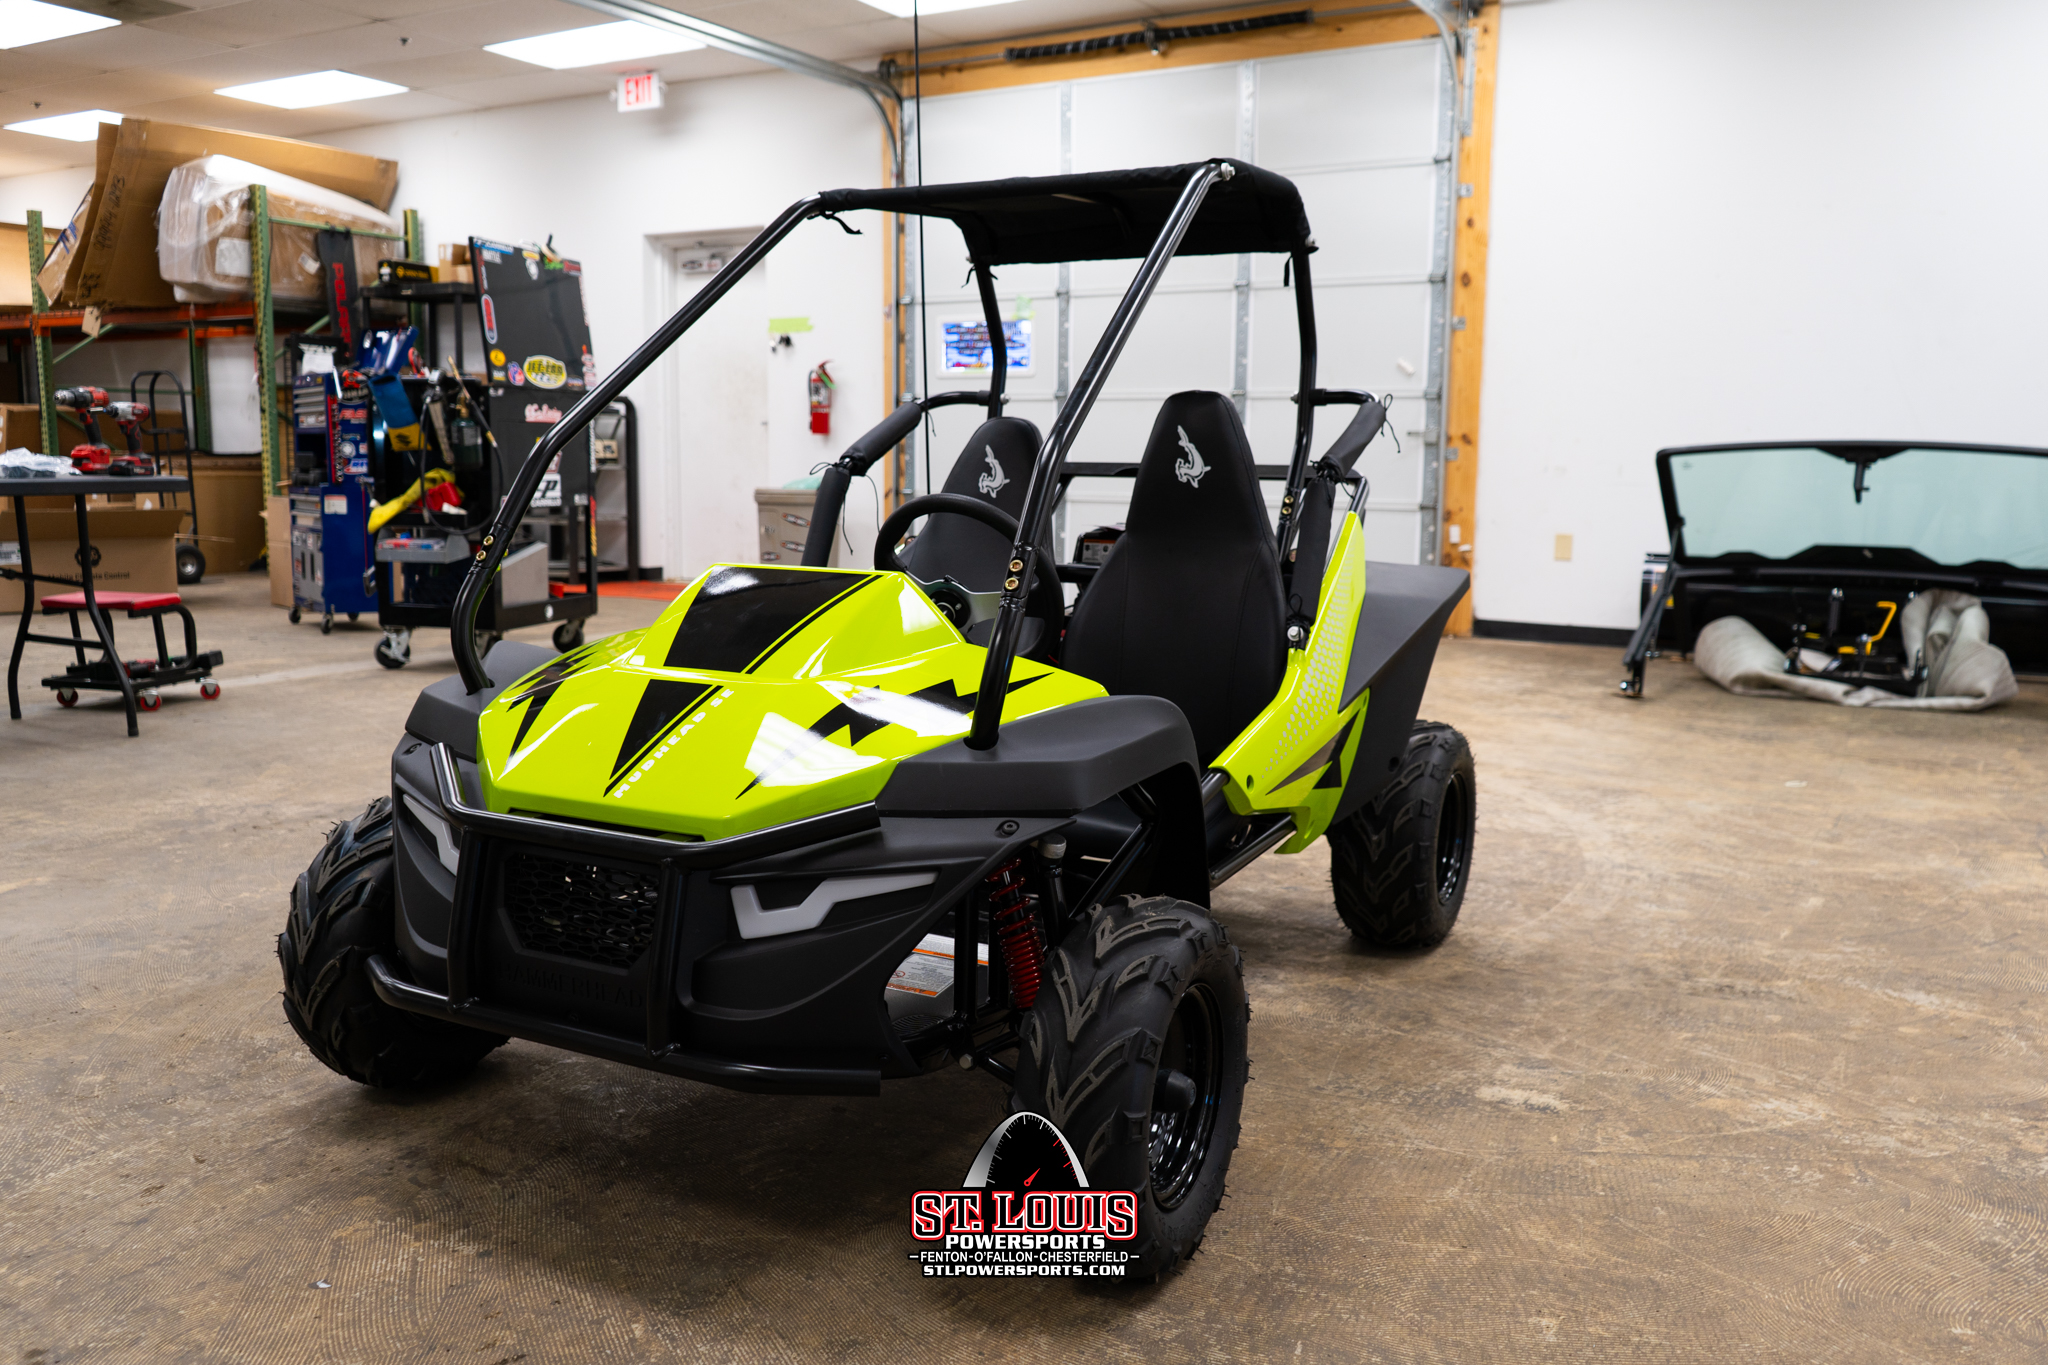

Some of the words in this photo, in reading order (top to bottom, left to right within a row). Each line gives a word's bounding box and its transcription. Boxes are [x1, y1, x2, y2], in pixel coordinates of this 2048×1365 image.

[624, 74, 653, 107] EXIT
[104, 571, 130, 580] Control
[613, 711, 706, 798] MUDHEAD
[710, 688, 735, 707] SE
[499, 962, 642, 1007] HAMMERHEAD
